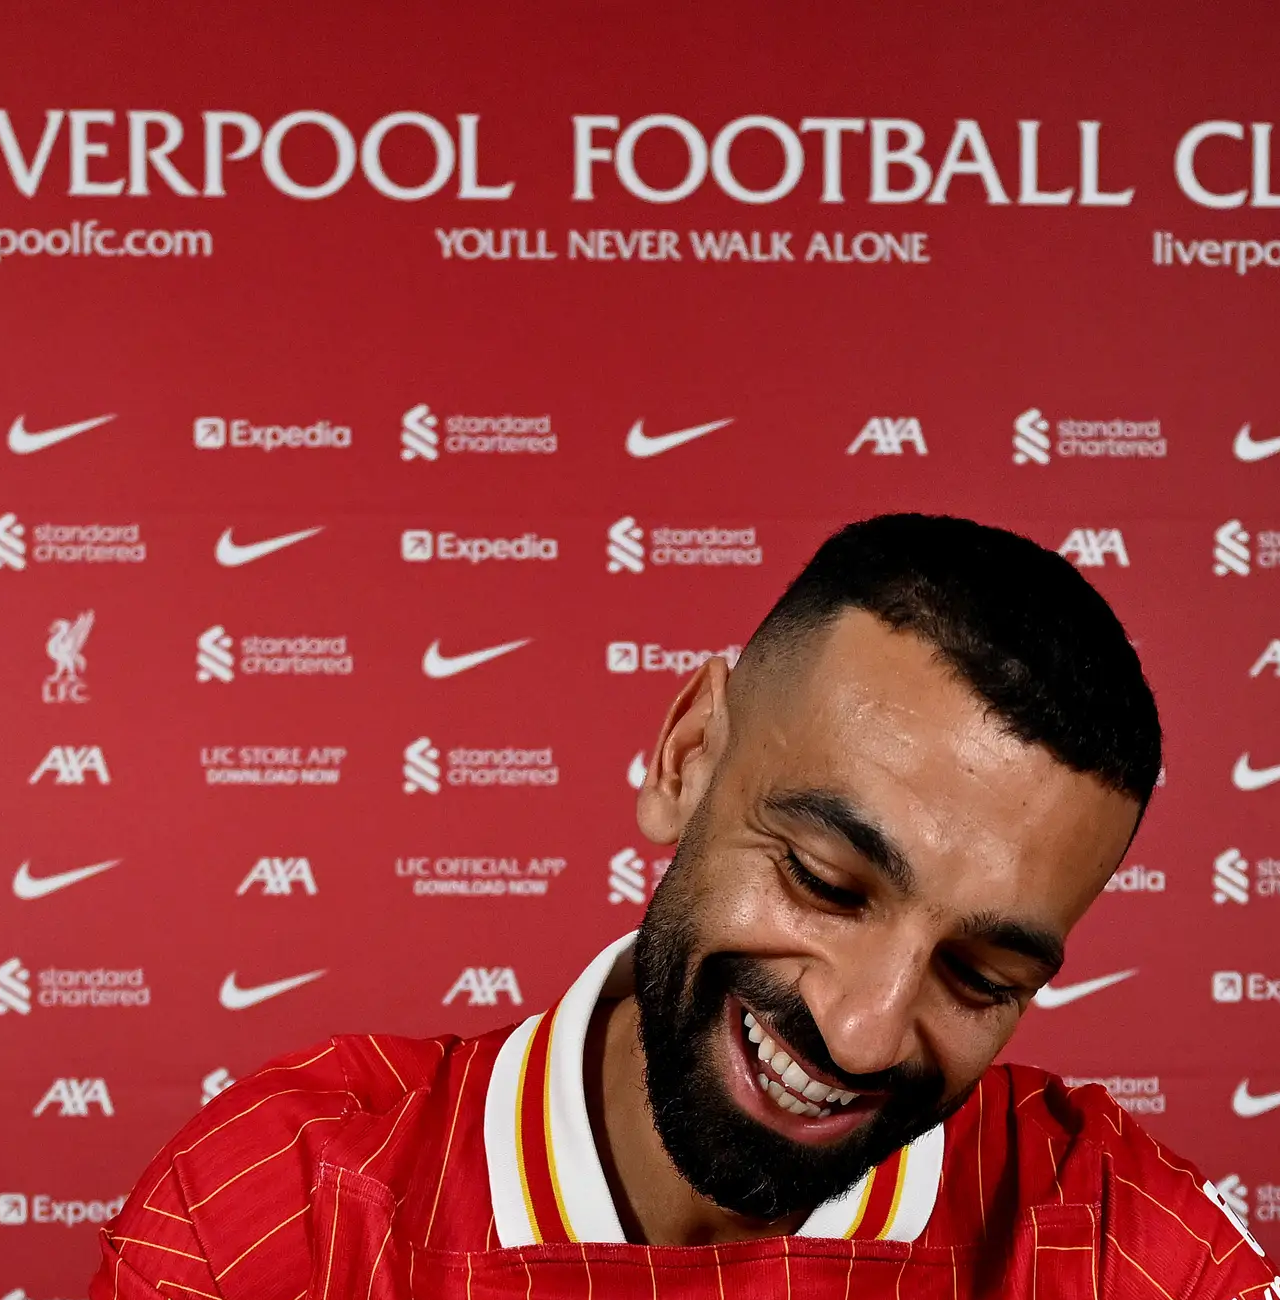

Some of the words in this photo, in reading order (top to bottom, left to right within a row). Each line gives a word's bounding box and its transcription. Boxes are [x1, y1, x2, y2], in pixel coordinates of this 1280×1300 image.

[573, 114, 1135, 206] FOOTBALL
[435, 228, 557, 260] YOU'LL
[568, 229, 681, 260] NEVER
[689, 231, 795, 262] WALK
[805, 232, 930, 263] ALONE
[229, 419, 351, 451] Expedia
[1057, 419, 1159, 439] standard
[1056, 437, 1167, 457] chartered
[33, 523, 138, 544] standard
[32, 542, 146, 563] chartered
[1055, 528, 1130, 567] AXA
[241, 636, 345, 656] standard
[240, 654, 353, 674] chartered
[29, 746, 110, 784] AXA
[306, 747, 347, 765] APP
[448, 748, 551, 767] standard
[206, 767, 296, 784] DOWNLOAD
[300, 765, 340, 784] NOW
[447, 765, 559, 785] chartered
[237, 857, 317, 895] AXA
[526, 857, 567, 876] APP
[414, 879, 504, 895] DOWNLOAD
[508, 879, 548, 895] NOW
[443, 968, 523, 1005] AXA
[34, 1078, 114, 1116] AXA
